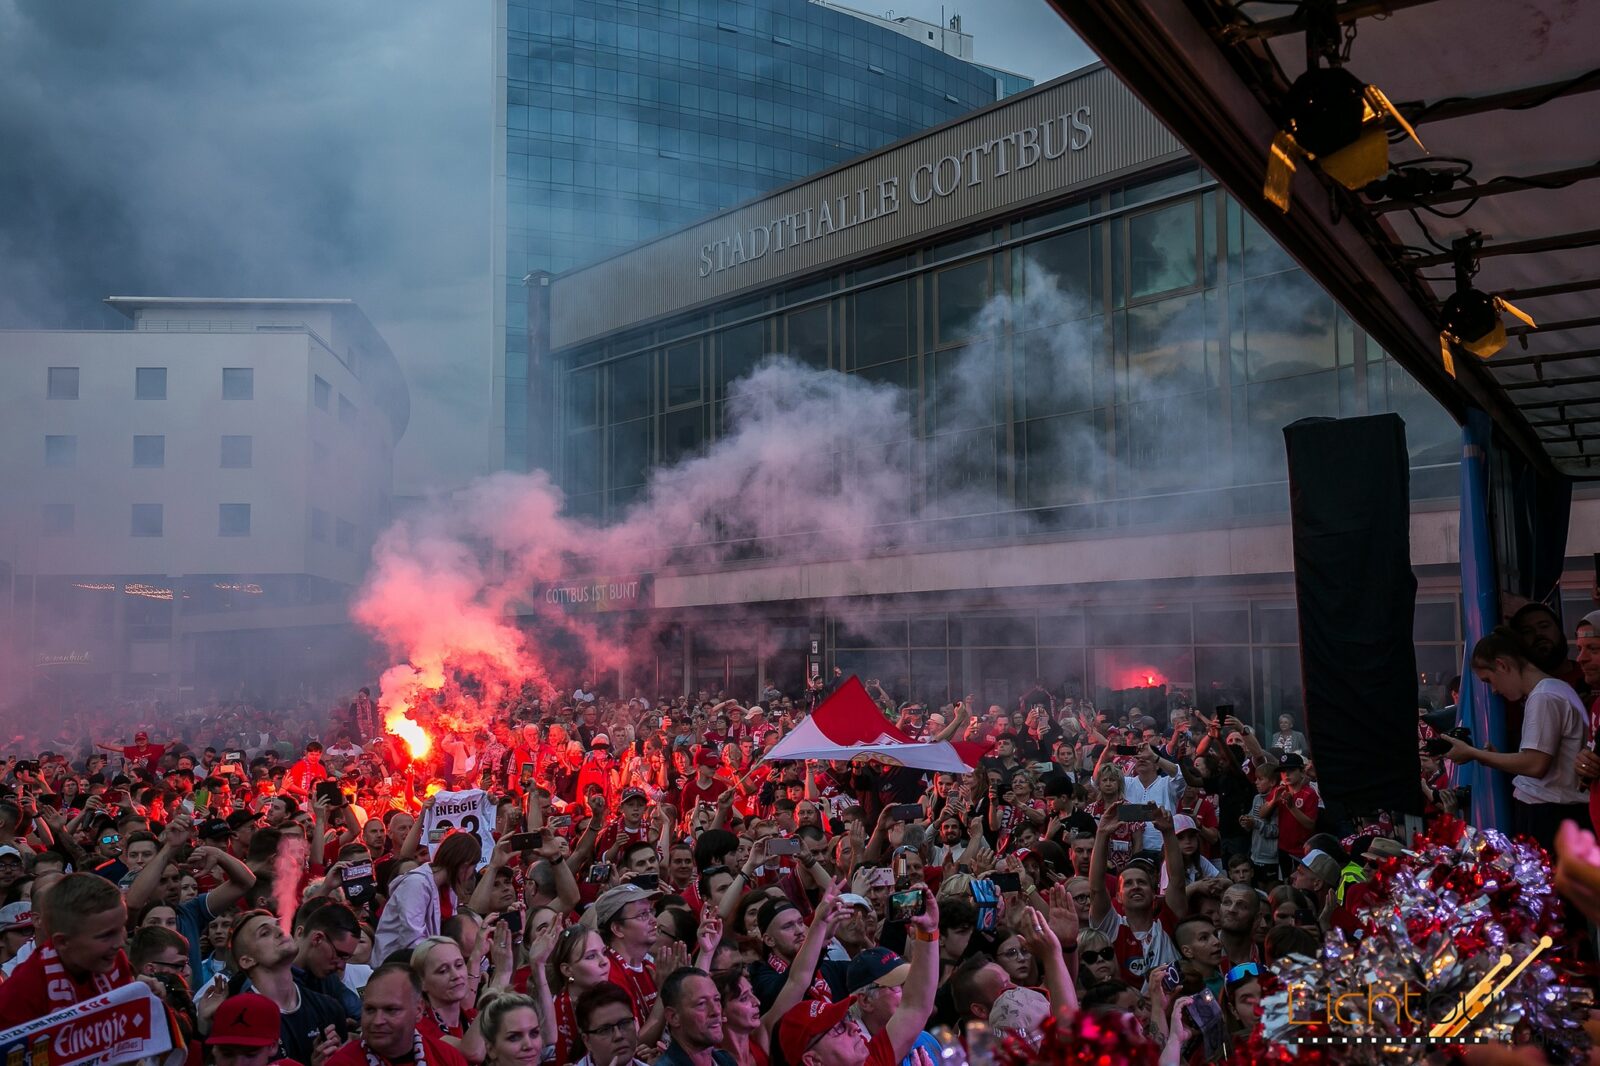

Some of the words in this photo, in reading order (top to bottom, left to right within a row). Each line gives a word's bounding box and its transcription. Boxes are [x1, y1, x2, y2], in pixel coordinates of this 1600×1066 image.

[699, 177, 899, 279] STADTHALLE
[908, 105, 1093, 205] COTTBUS
[545, 585, 589, 604] COTTBUS
[592, 584, 607, 601] IST
[609, 581, 638, 600] BUNT
[435, 800, 478, 816] ENERGIE
[54, 1012, 128, 1057] Energie
